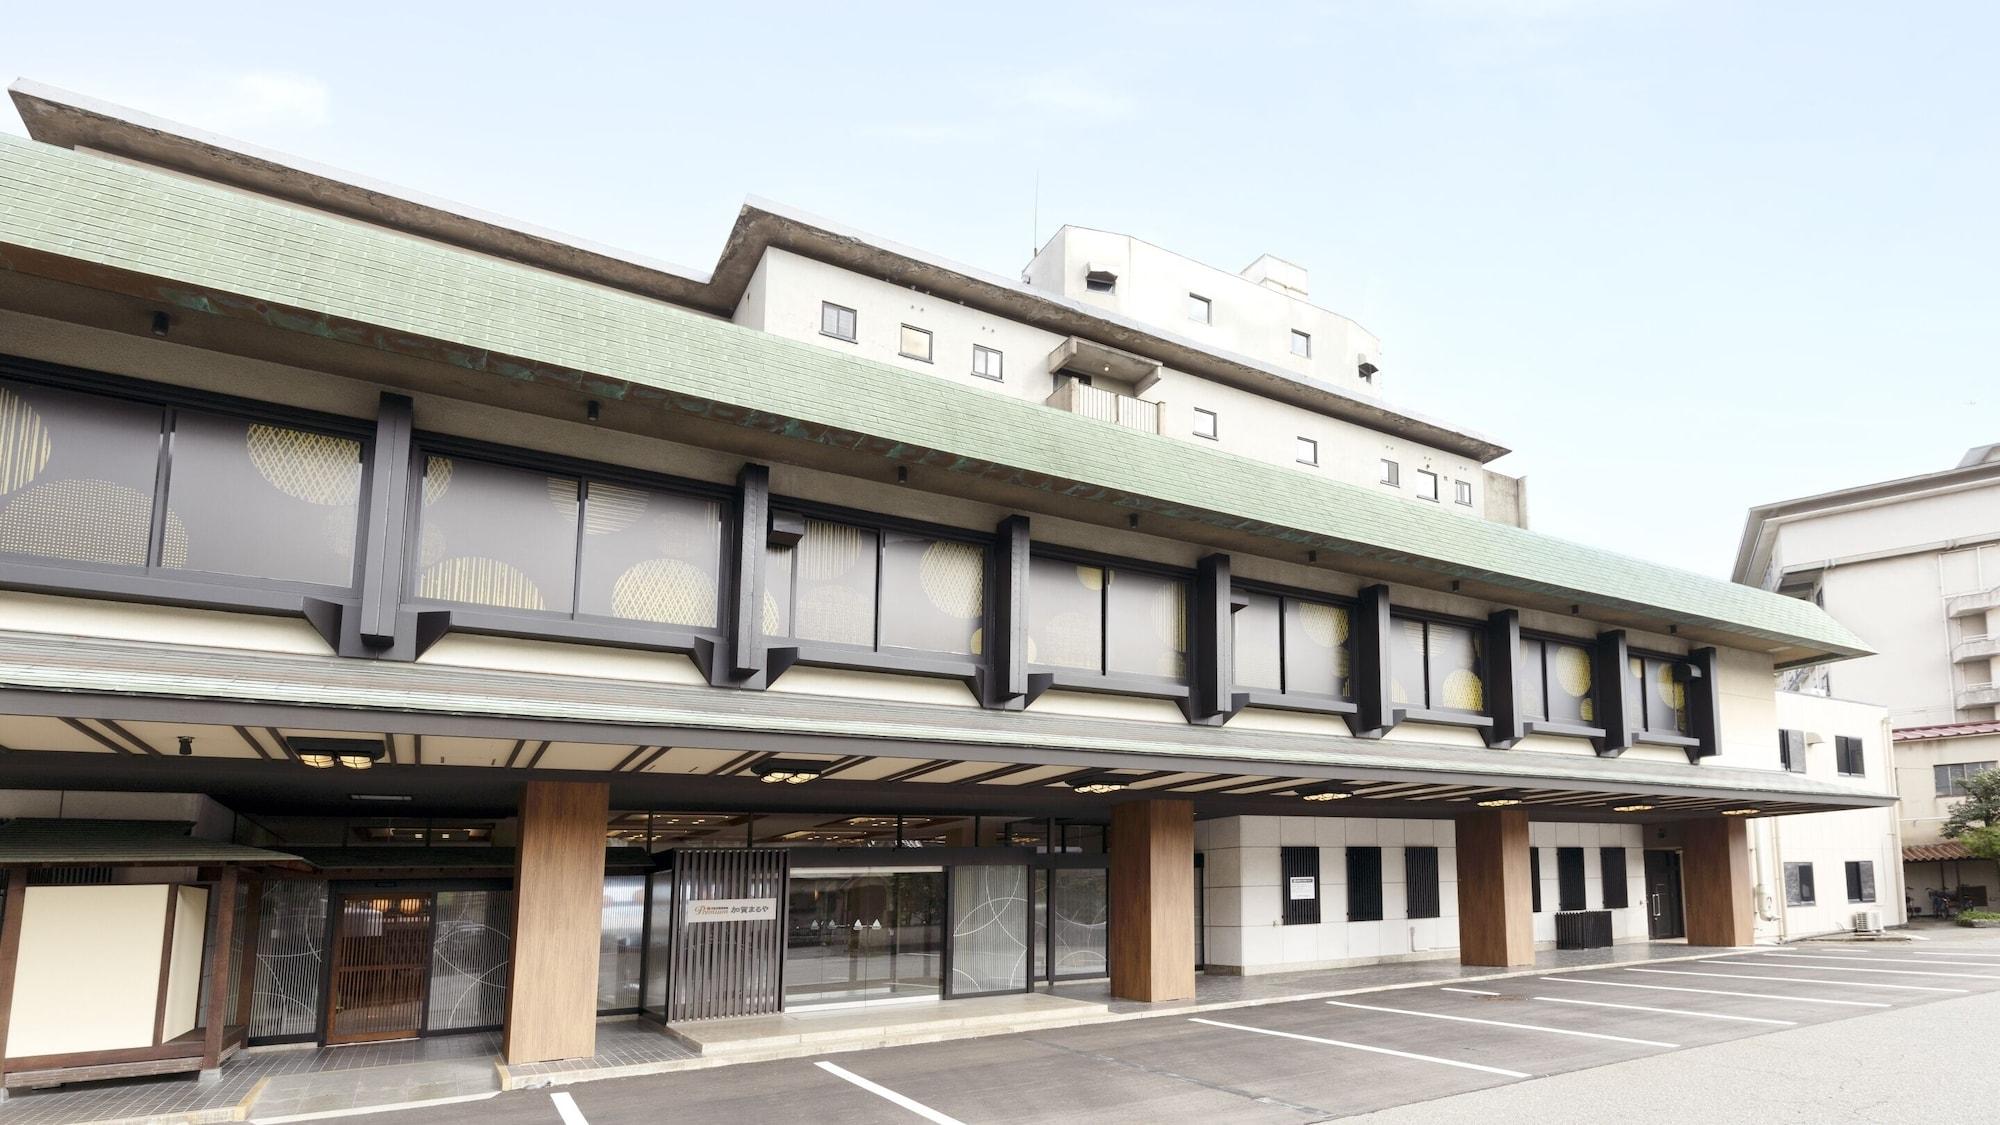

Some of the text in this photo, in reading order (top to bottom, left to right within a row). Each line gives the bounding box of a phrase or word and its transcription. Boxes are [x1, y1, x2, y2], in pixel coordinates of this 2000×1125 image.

[694, 905, 729, 915] Premium
[730, 905, 769, 914] 加賀まるや
